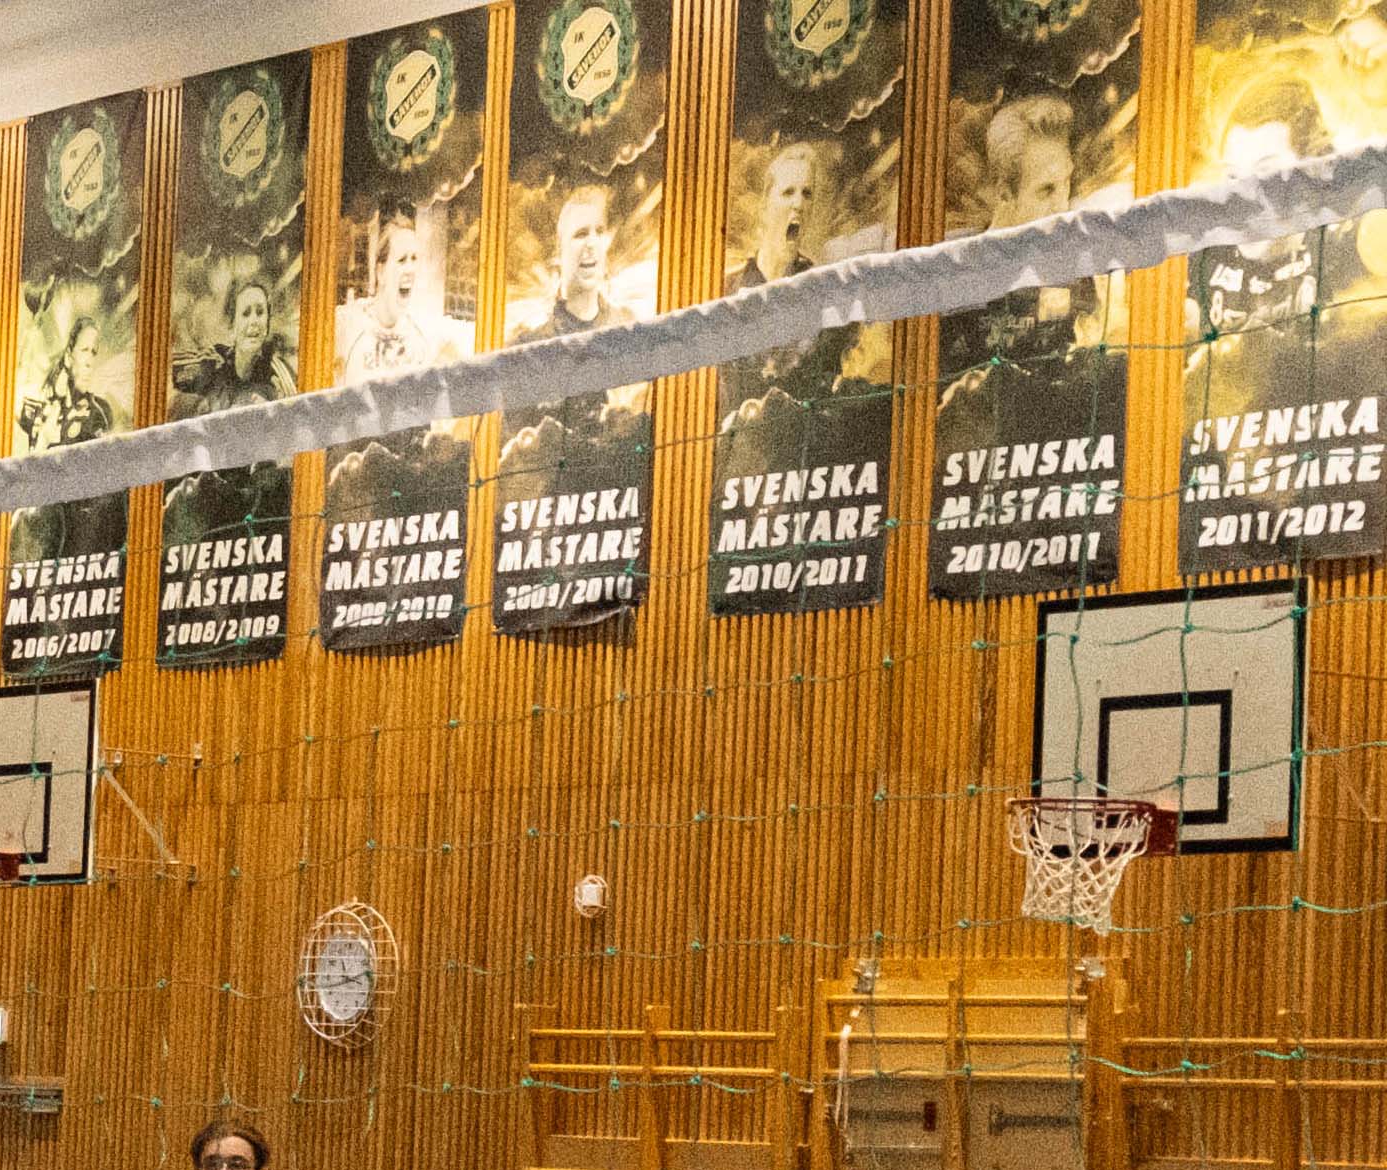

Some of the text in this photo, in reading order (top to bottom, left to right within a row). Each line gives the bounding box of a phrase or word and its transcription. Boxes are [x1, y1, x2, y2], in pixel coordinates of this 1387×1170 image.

[1190, 396, 1379, 456] SVENSKA
[942, 434, 1115, 486] SVENSKA
[1185, 443, 1385, 503] MÄSTARE
[721, 461, 878, 510] SVENSKA
[936, 480, 1120, 531] MÄSTARE
[501, 487, 639, 532] SVENSKA
[718, 504, 883, 553] MÄSTARE
[1198, 499, 1366, 547] 2011/2012
[328, 510, 460, 553] SVENSKA
[497, 527, 643, 573] MÄSTARE
[946, 532, 1101, 574] 2010/2011
[9, 550, 119, 590] SVENSKA
[165, 533, 283, 574] SVENSKA
[325, 548, 463, 591] MÄSTARE
[725, 555, 868, 593] 2010/2011
[5, 586, 123, 625] MÄSTARE
[162, 570, 286, 611] MÄSTARE
[11, 628, 116, 659] 2006/2007
[165, 614, 280, 646] 2008/2009
